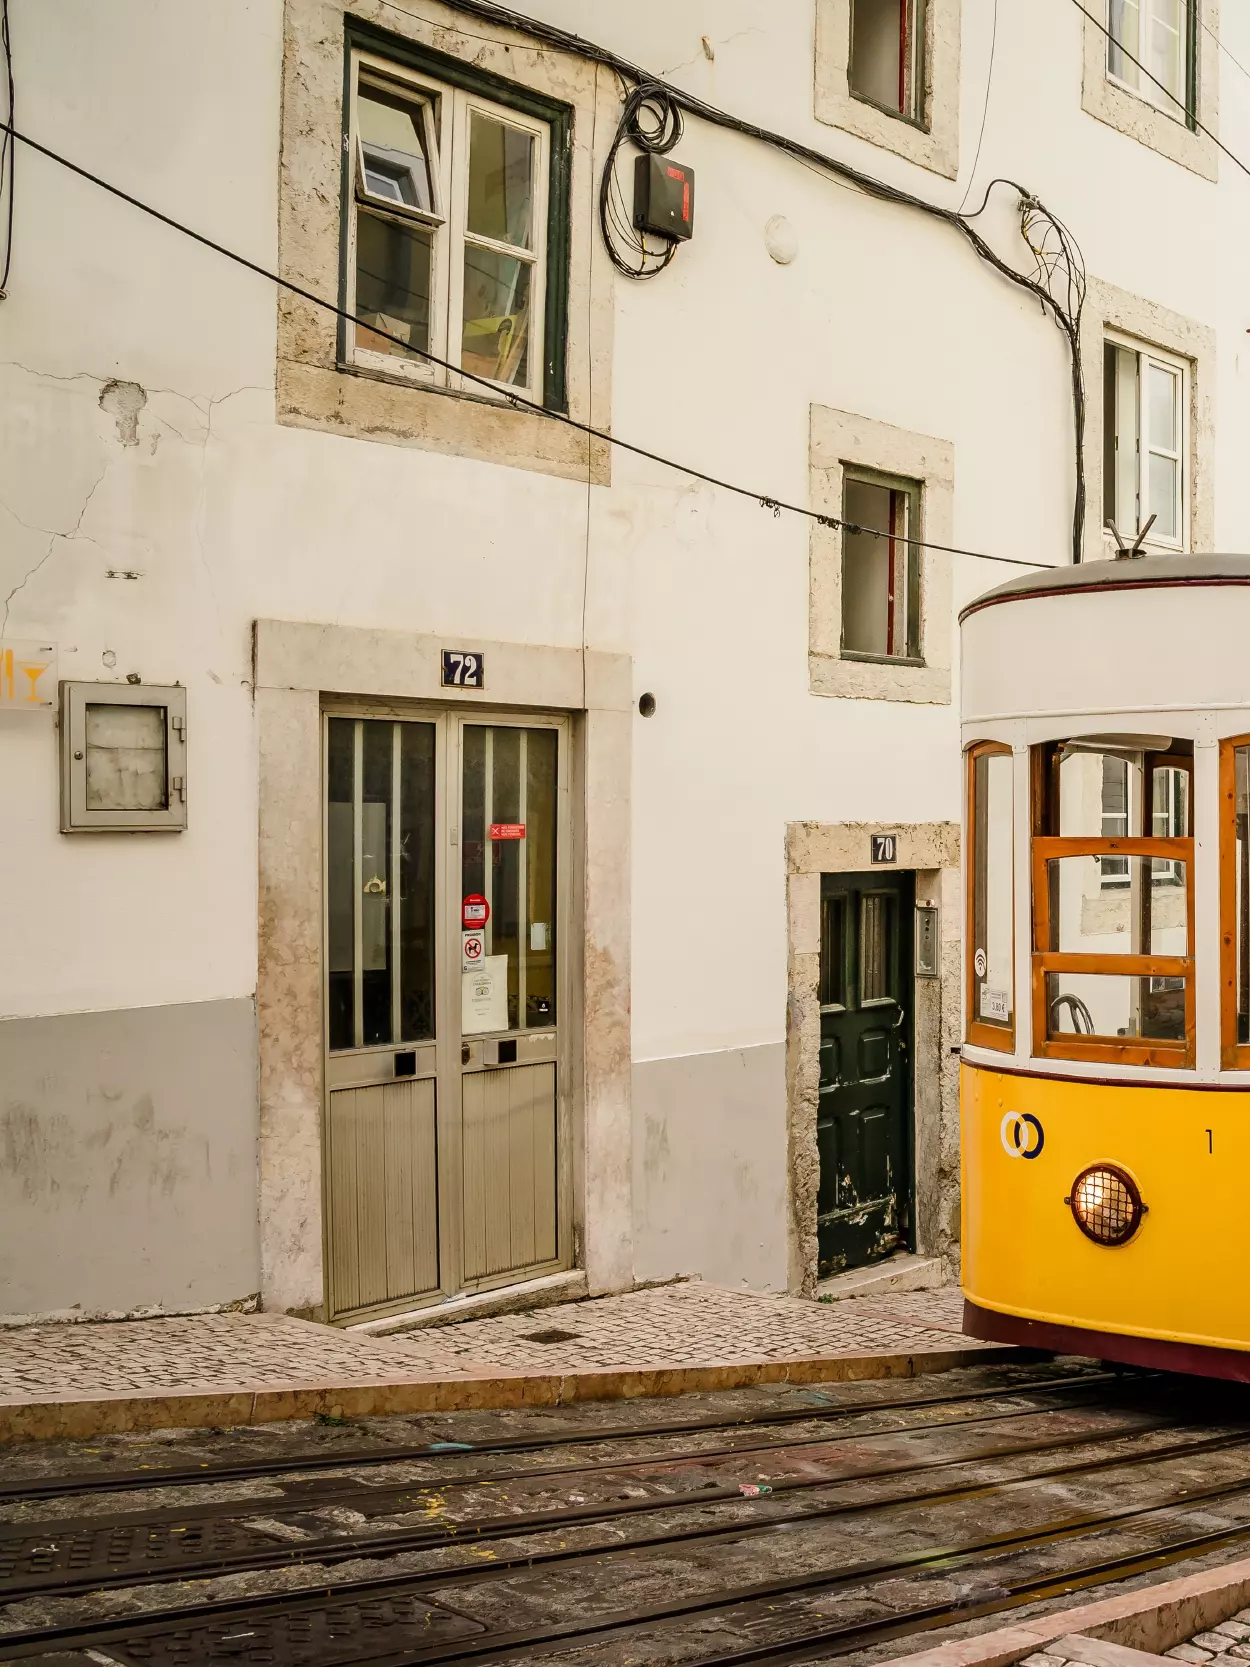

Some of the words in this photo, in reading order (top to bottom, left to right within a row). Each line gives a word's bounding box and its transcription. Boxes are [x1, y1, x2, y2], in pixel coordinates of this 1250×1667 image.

[450, 653, 477, 686] 72
[876, 837, 894, 861] 70
[1204, 1128, 1213, 1154] 1
